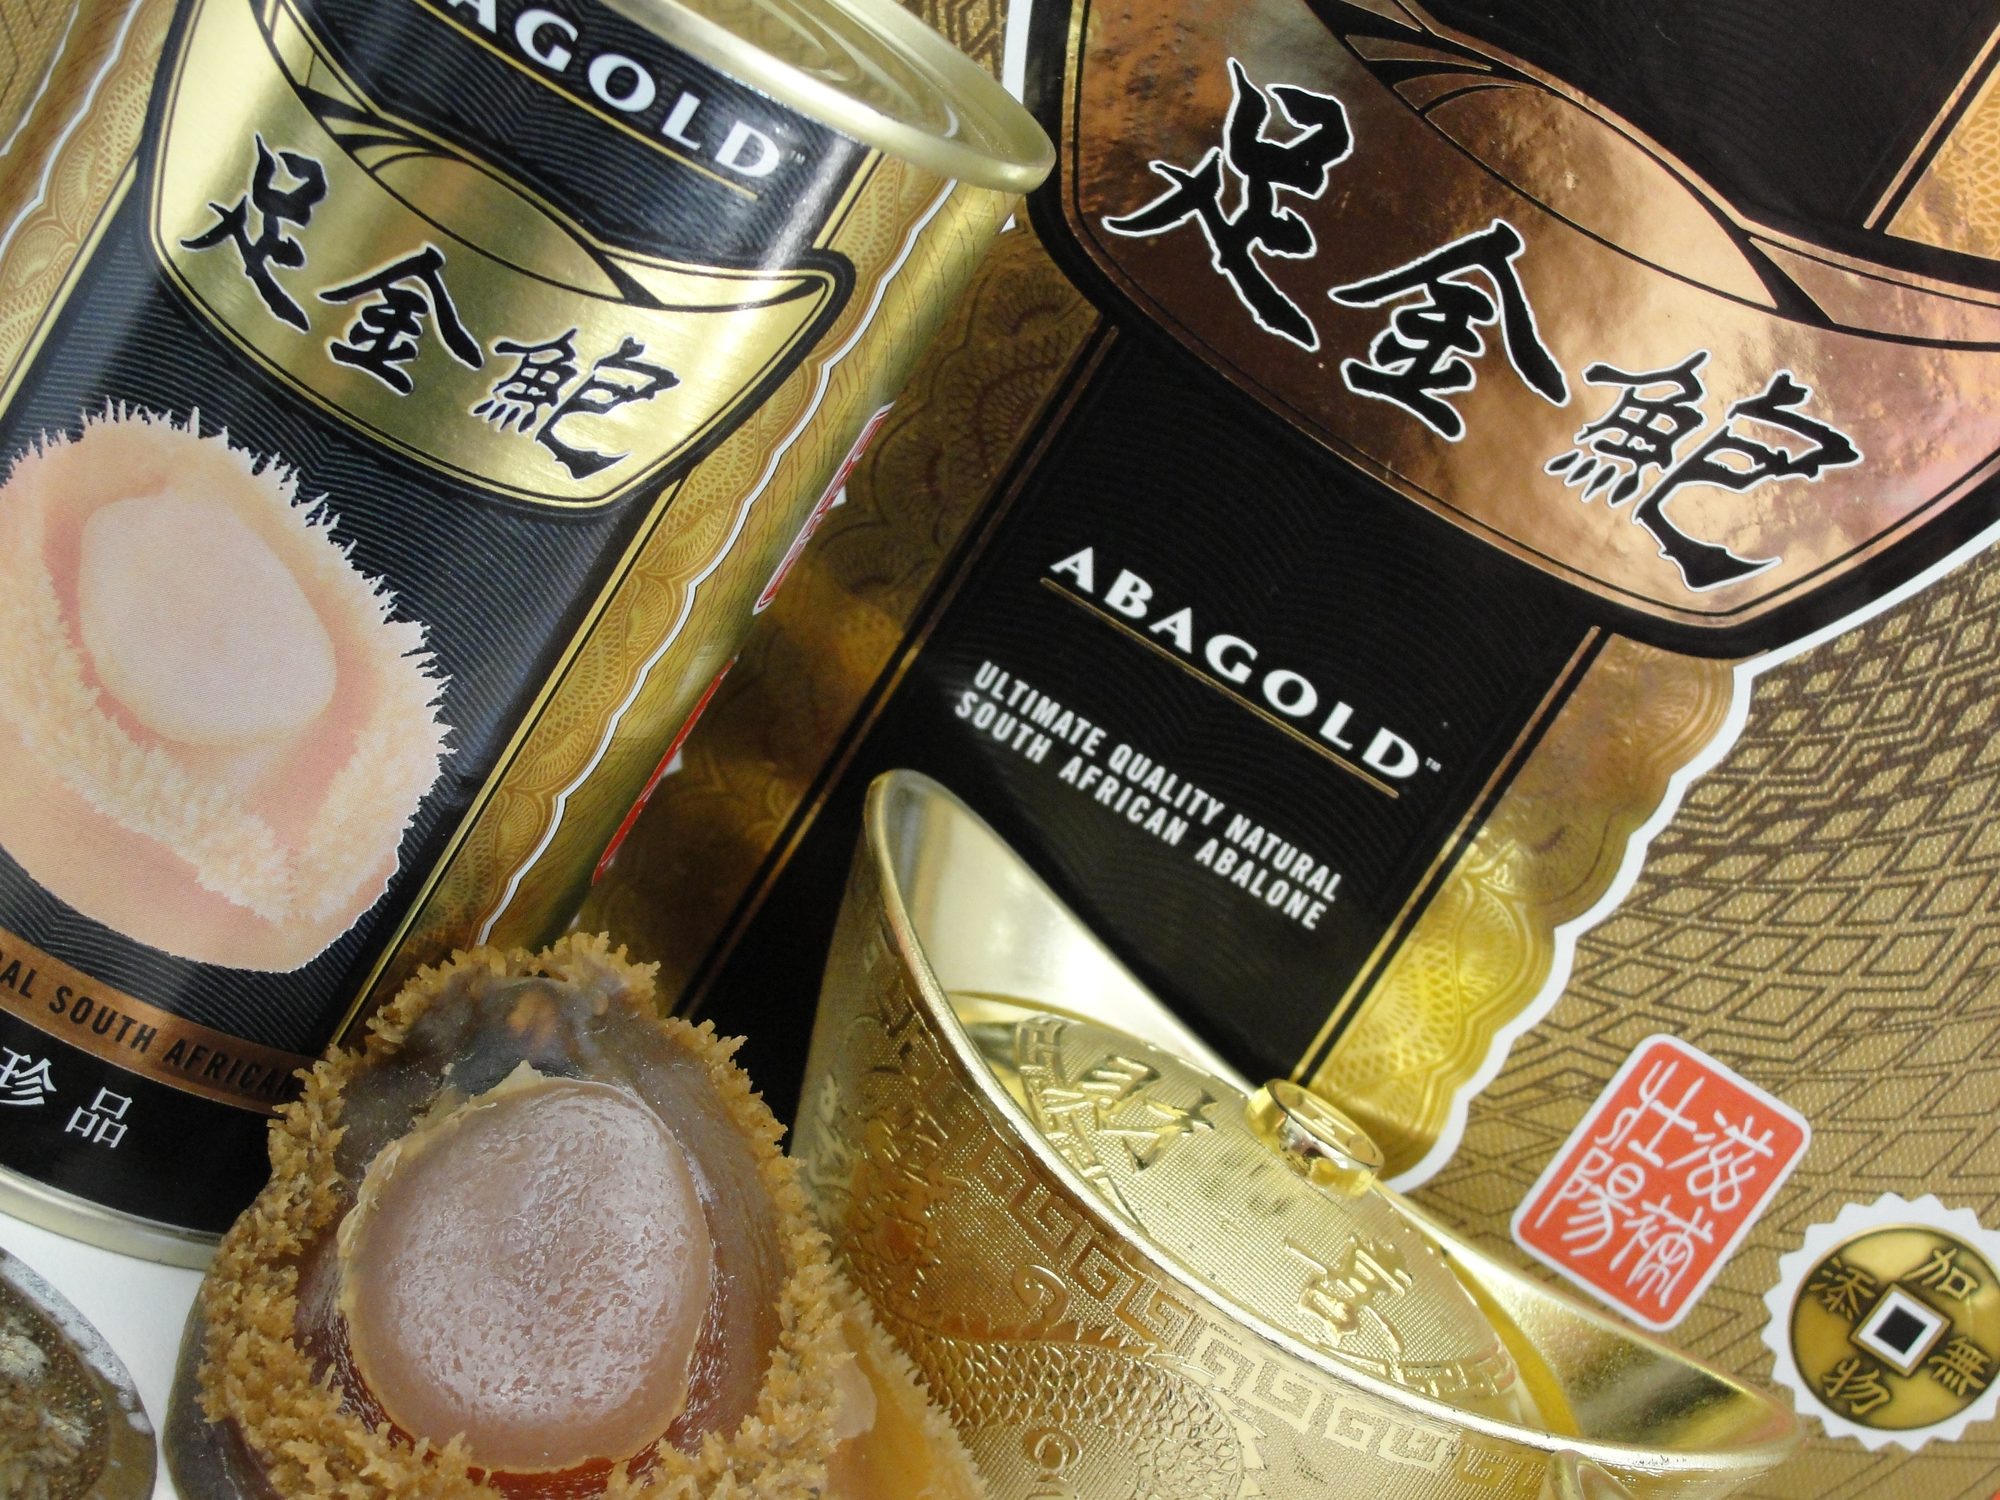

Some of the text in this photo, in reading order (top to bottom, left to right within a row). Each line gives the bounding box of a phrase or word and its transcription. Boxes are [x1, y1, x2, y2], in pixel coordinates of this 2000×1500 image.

[1050, 546, 1420, 779] ABAGOLD
[954, 691, 1328, 930] SOUTH AFRICAN ABALONE
[974, 660, 1342, 902] ULTIMATE QUALITY NATURAL
[0, 951, 38, 999] AL
[48, 985, 158, 1054] SOUTH
[0, 1046, 133, 1149] 珍品
